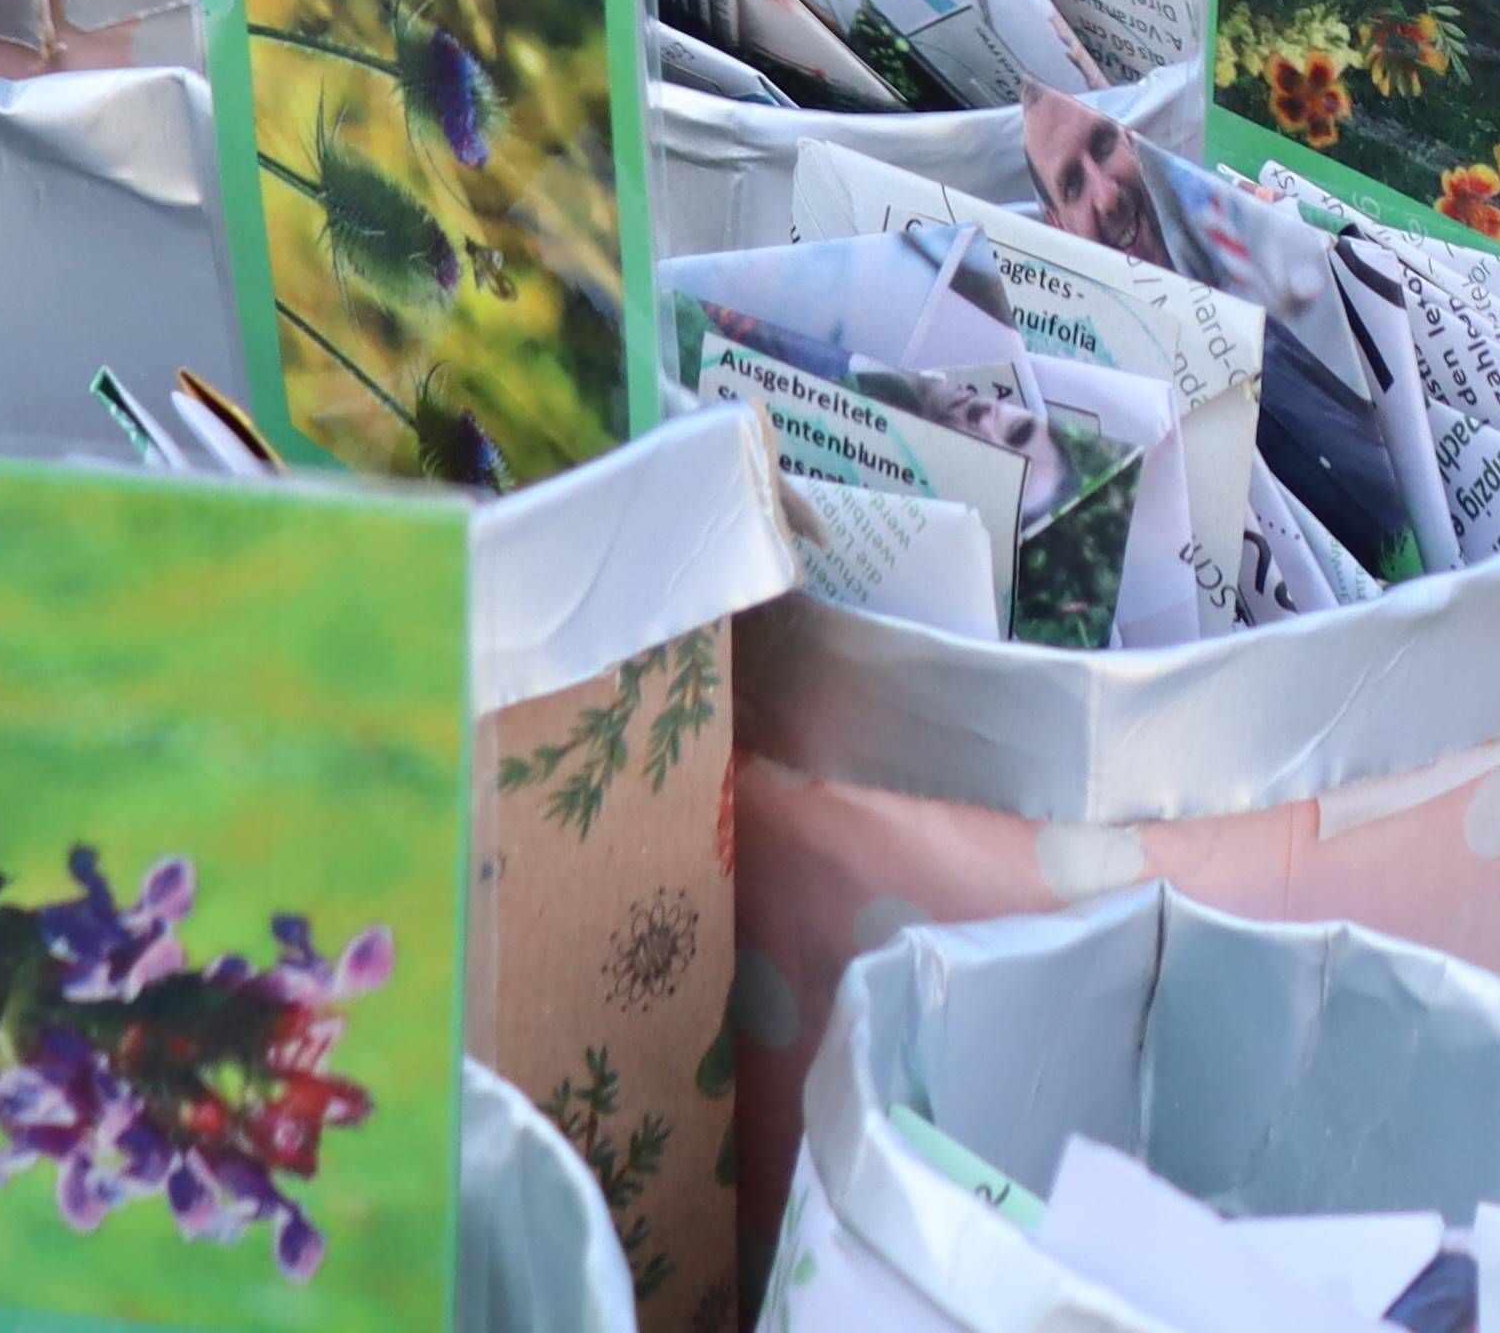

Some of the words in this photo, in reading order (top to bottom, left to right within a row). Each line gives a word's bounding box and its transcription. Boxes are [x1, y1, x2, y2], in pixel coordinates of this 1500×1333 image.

[993, 249, 1073, 300] agetes
[1011, 304, 1098, 352] nuifolia
[719, 348, 889, 434] Ausgebreitete
[1442, 348, 1479, 407] den
